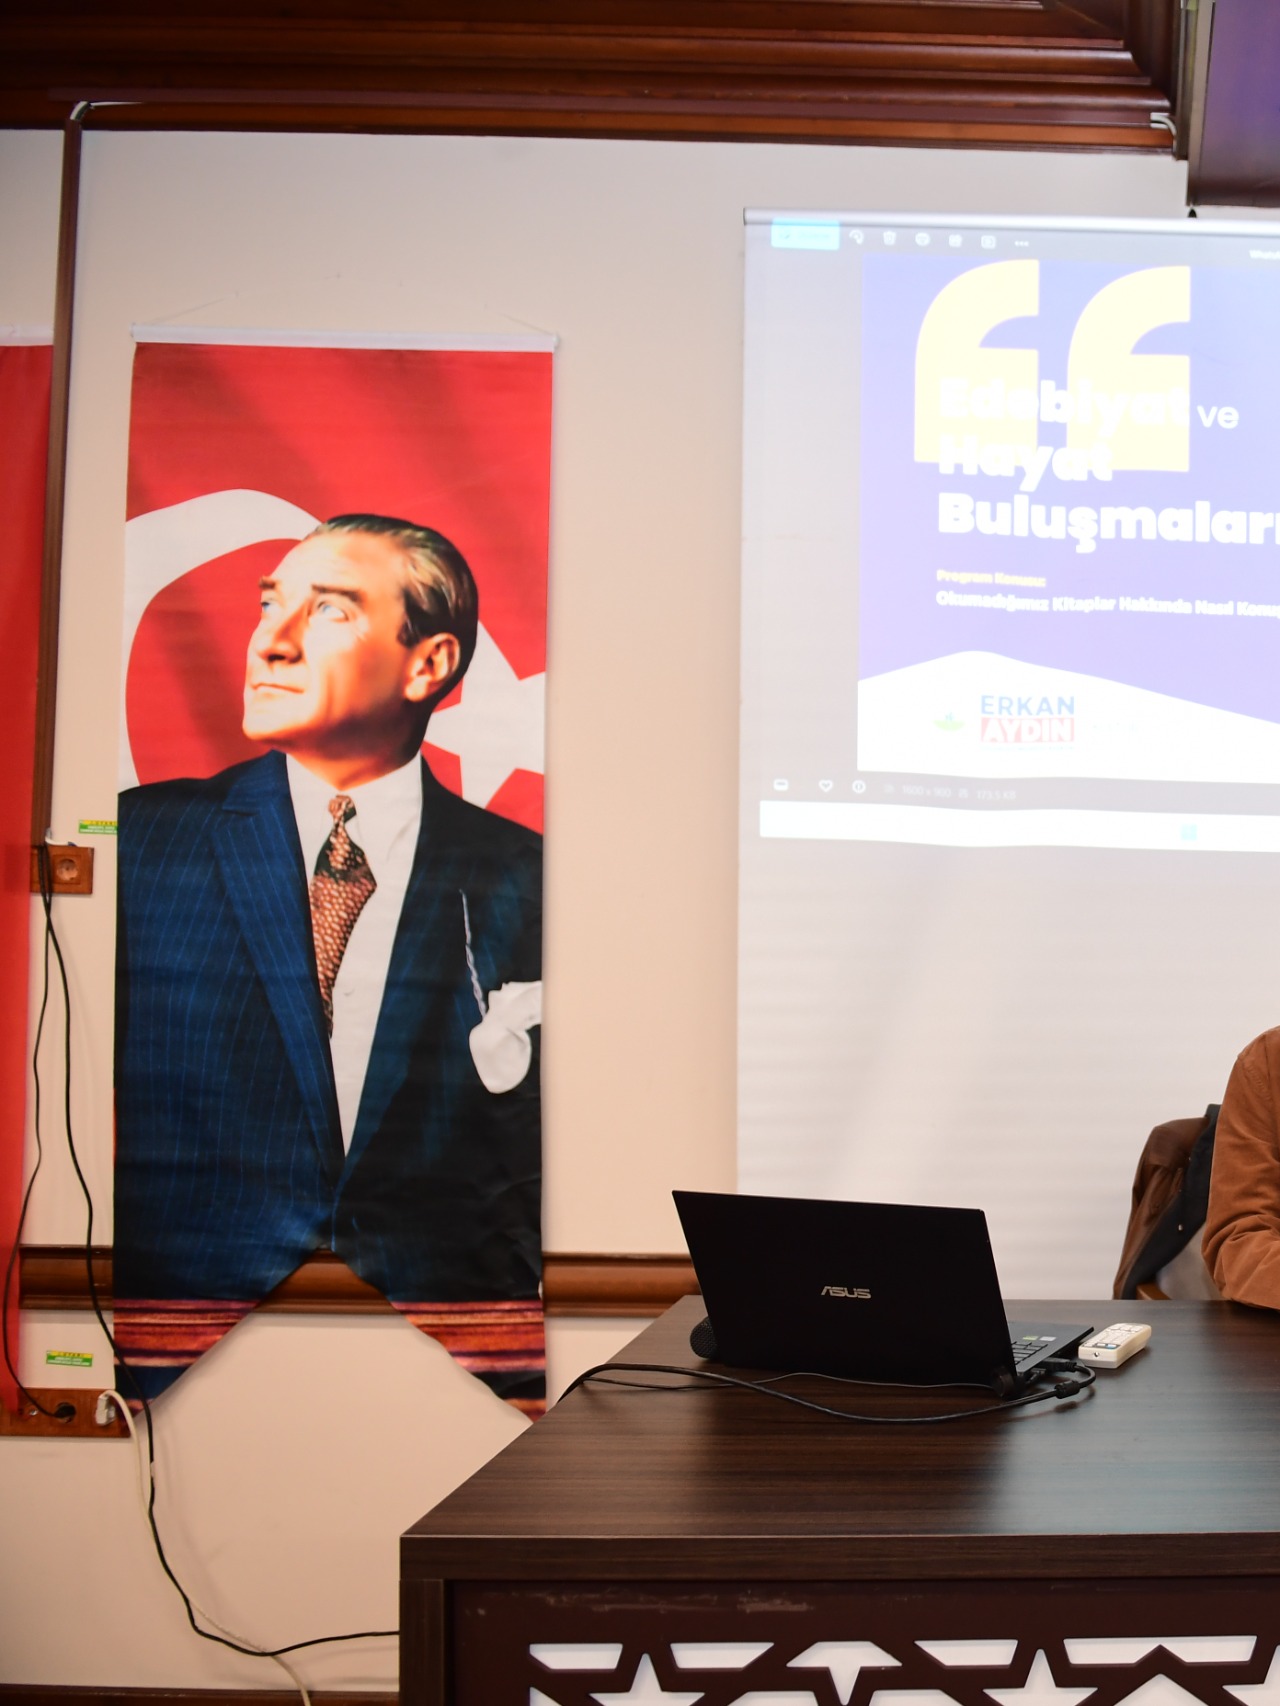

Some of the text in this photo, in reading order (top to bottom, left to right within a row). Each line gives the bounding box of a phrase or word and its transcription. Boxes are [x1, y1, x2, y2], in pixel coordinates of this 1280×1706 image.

[938, 377, 1240, 438] Edebiyat ve
[938, 435, 1114, 493] Hayat
[936, 569, 993, 585] Program
[1052, 595, 1116, 614] Kitaplar
[1119, 597, 1193, 615] Hakkında
[1196, 599, 1234, 616] Nasıl
[980, 695, 1075, 715] ERKAN
[981, 718, 1073, 743] AYDIN
[820, 1285, 872, 1299] ASUS
